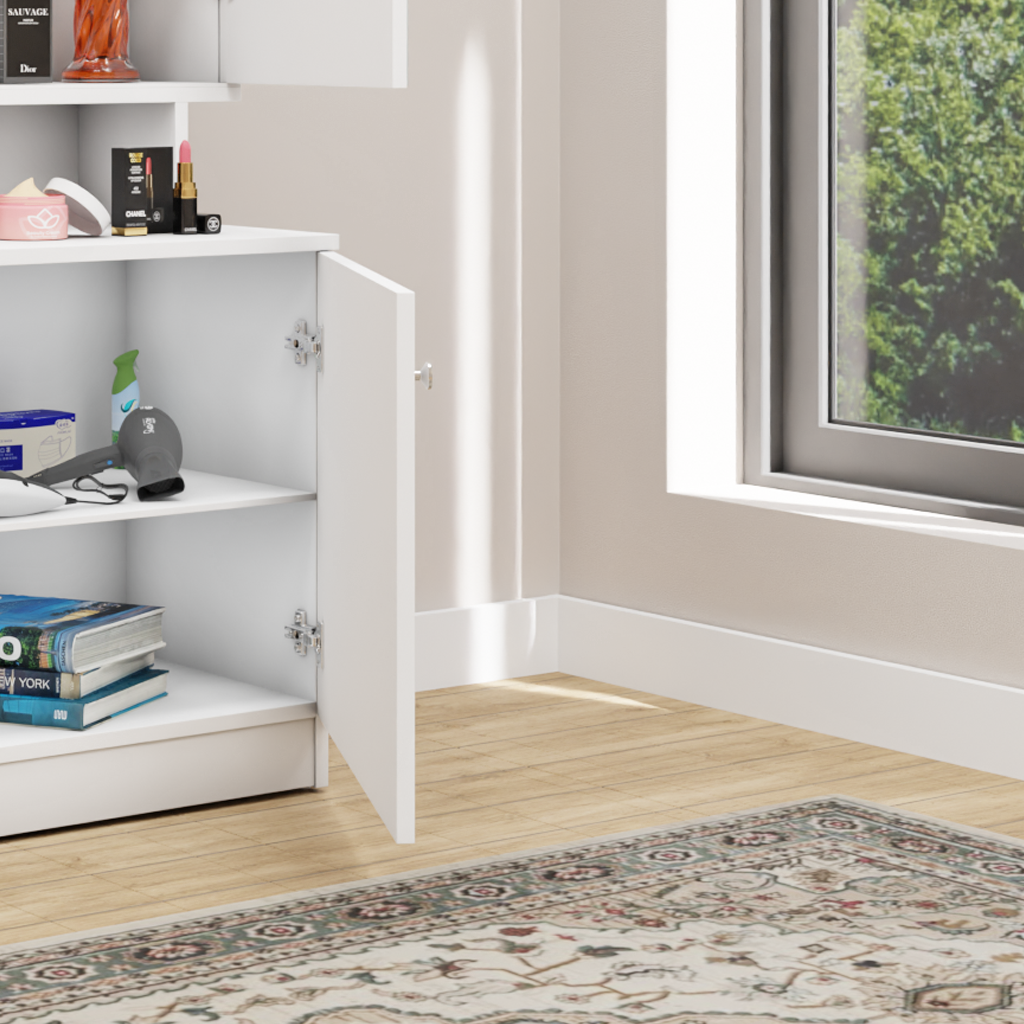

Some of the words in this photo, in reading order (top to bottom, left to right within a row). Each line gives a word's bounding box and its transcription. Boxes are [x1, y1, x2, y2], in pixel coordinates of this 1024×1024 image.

[7, 7, 49, 17] SAUVAGE
[20, 64, 37, 74] Dior
[125, 210, 146, 218] CHANEL
[18, 677, 50, 690] YORK
